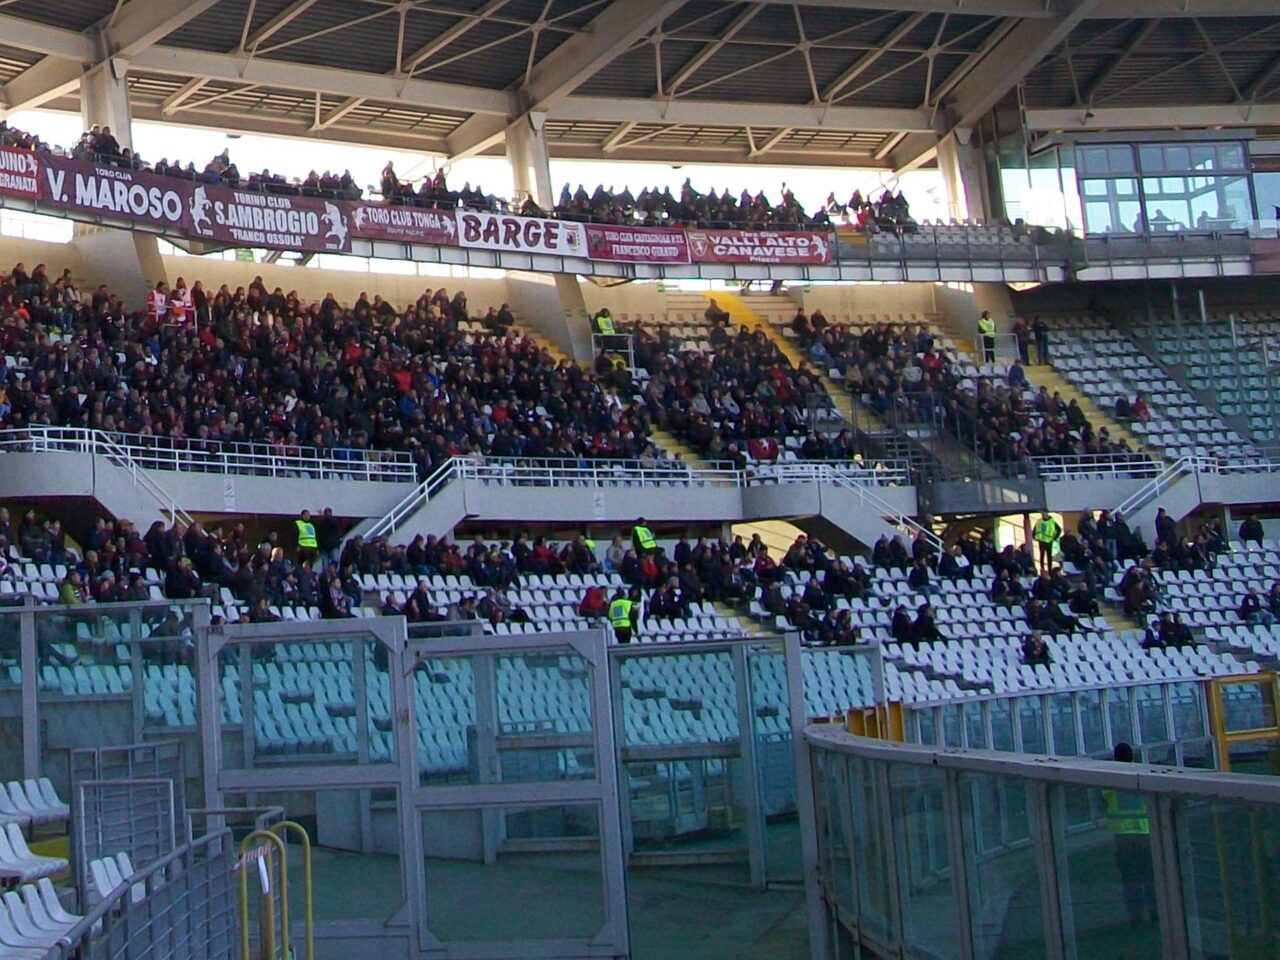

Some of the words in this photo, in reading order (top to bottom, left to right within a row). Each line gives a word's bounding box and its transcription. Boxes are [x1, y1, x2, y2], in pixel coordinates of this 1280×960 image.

[95, 168, 115, 177] TORO
[115, 171, 132, 181] CLUB
[46, 168, 68, 202] V.
[75, 173, 182, 221] MAROSO
[234, 192, 266, 206] TORINO
[267, 196, 291, 209] CLUB
[214, 201, 319, 235] S.AMBROGIO
[367, 207, 389, 224] TORO
[390, 210, 412, 226] CLUB
[412, 212, 441, 229] TONGA
[462, 214, 560, 249] BARGE
[709, 236, 760, 246] VALLI
[766, 237, 809, 247] ALTO
[713, 246, 809, 257] CANAVESE
